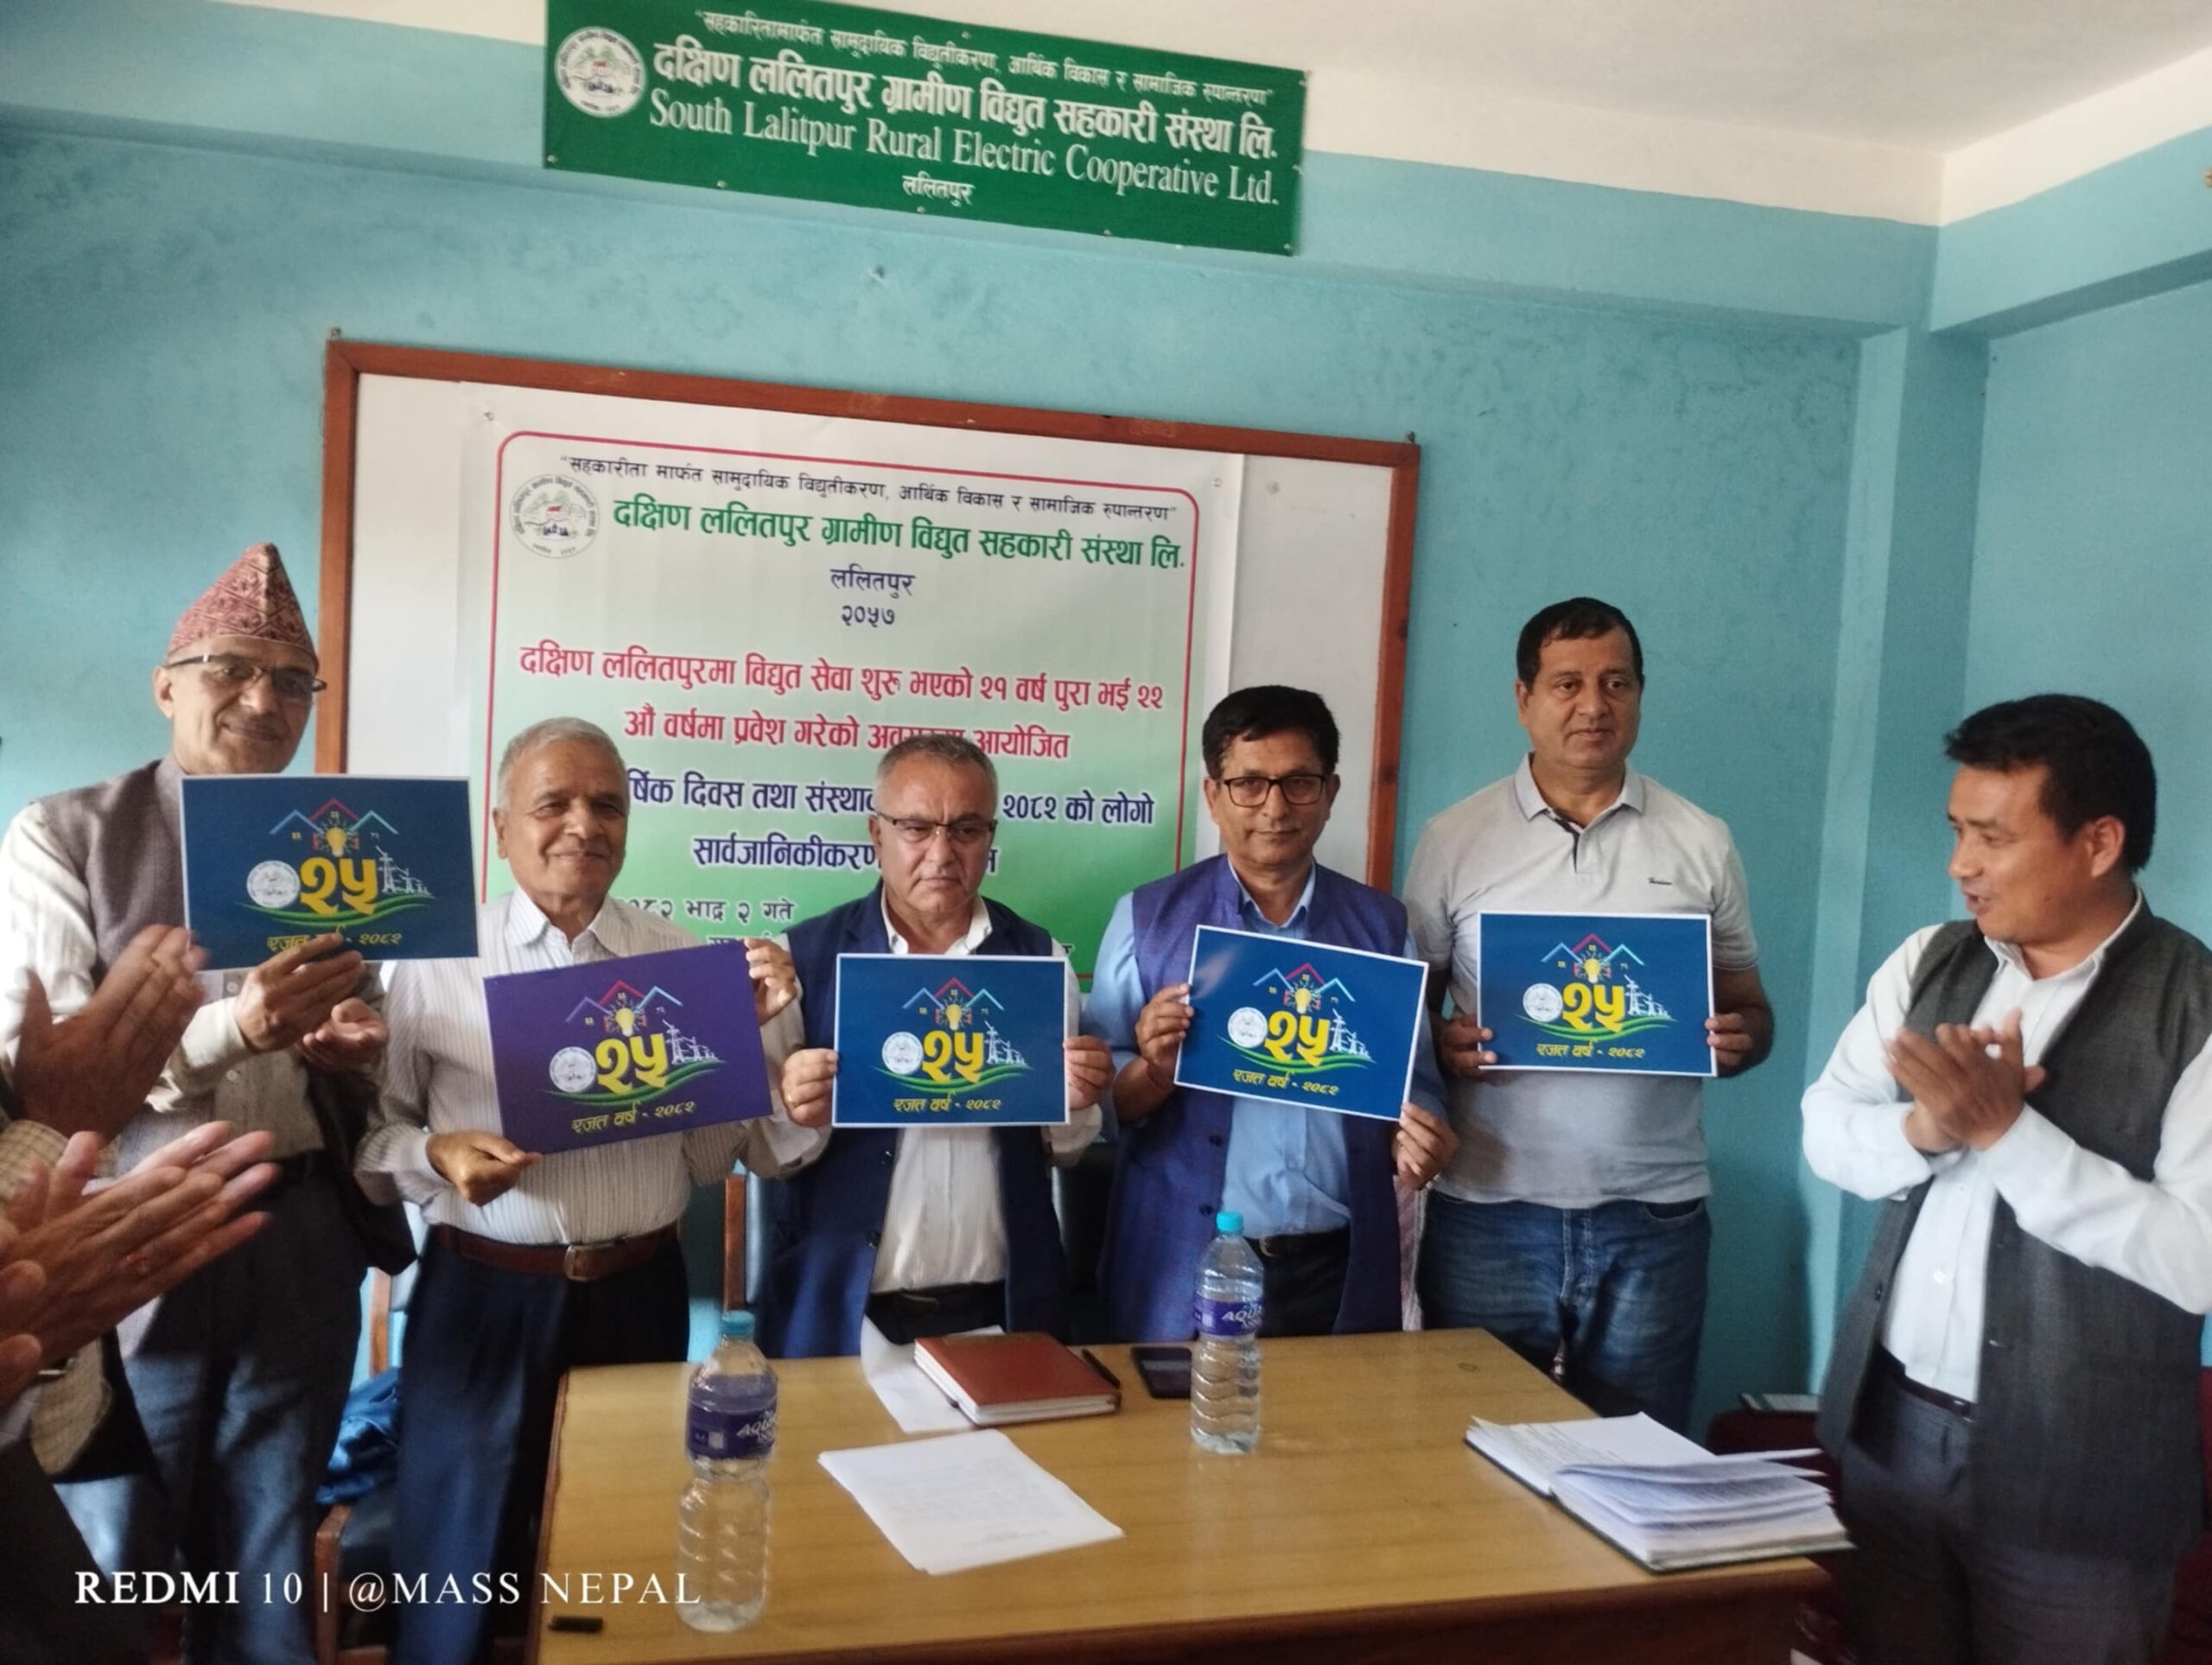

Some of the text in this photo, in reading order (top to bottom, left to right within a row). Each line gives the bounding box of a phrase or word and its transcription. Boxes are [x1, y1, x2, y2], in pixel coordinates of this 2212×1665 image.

[653, 34, 742, 88] दक्षिण
[749, 48, 876, 115] ललितपुर
[881, 71, 974, 120] ग्रामीण
[980, 78, 1047, 137] विद्युत
[1053, 99, 1158, 144] सहकारी
[1165, 109, 1235, 153] संस्था
[1239, 112, 1278, 160] लि.
[1063, 55, 1112, 88] विकास
[1116, 71, 1128, 93] र
[650, 87, 1279, 206] South Lalitpur Rural Electric Cooperative Ltd.
[902, 171, 976, 207] ललितपुर
[711, 468, 791, 491] सामुदायिक
[899, 482, 950, 503] आर्थिक
[957, 486, 1005, 508] विकास
[1011, 496, 1023, 512] र
[1029, 495, 1096, 516] सामाजिक
[613, 493, 692, 531] दक्षिण
[700, 500, 813, 547] ललितपुर
[821, 512, 903, 547] ग्रामीण
[911, 516, 971, 559] विद्युत
[979, 528, 1073, 561] सहकारी
[1081, 533, 1143, 565] संस्था
[1151, 534, 1184, 569] लि.
[830, 563, 915, 599] ललितपुर
[842, 604, 895, 627] २०५७
[520, 639, 594, 676] दक्षिण
[602, 645, 737, 690] ललितपुरमा
[745, 652, 803, 696] विद्युत
[810, 658, 854, 691] सेवा
[910, 666, 974, 698] भएको
[980, 677, 1007, 700] २१
[1015, 672, 1046, 702] वर्ष
[1054, 680, 1091, 712] पुरा
[1097, 677, 1131, 711] भई
[1137, 685, 1163, 709] २२
[664, 708, 726, 740] वर्षमा
[734, 709, 786, 745] प्रवेश
[794, 714, 860, 747] गरेको
[973, 724, 1071, 759] आयोजित
[683, 771, 745, 808] दिवस
[753, 783, 798, 810] तथा
[1003, 789, 1154, 824] २०८२ को लोगो
[300, 856, 379, 916] २५
[686, 900, 727, 921] भाद्र
[738, 902, 750, 923] २
[763, 898, 794, 920] गते
[1562, 982, 1626, 1033] २५
[922, 1030, 984, 1084] २५
[1264, 1010, 1331, 1067] २५
[595, 1033, 670, 1096] २५
